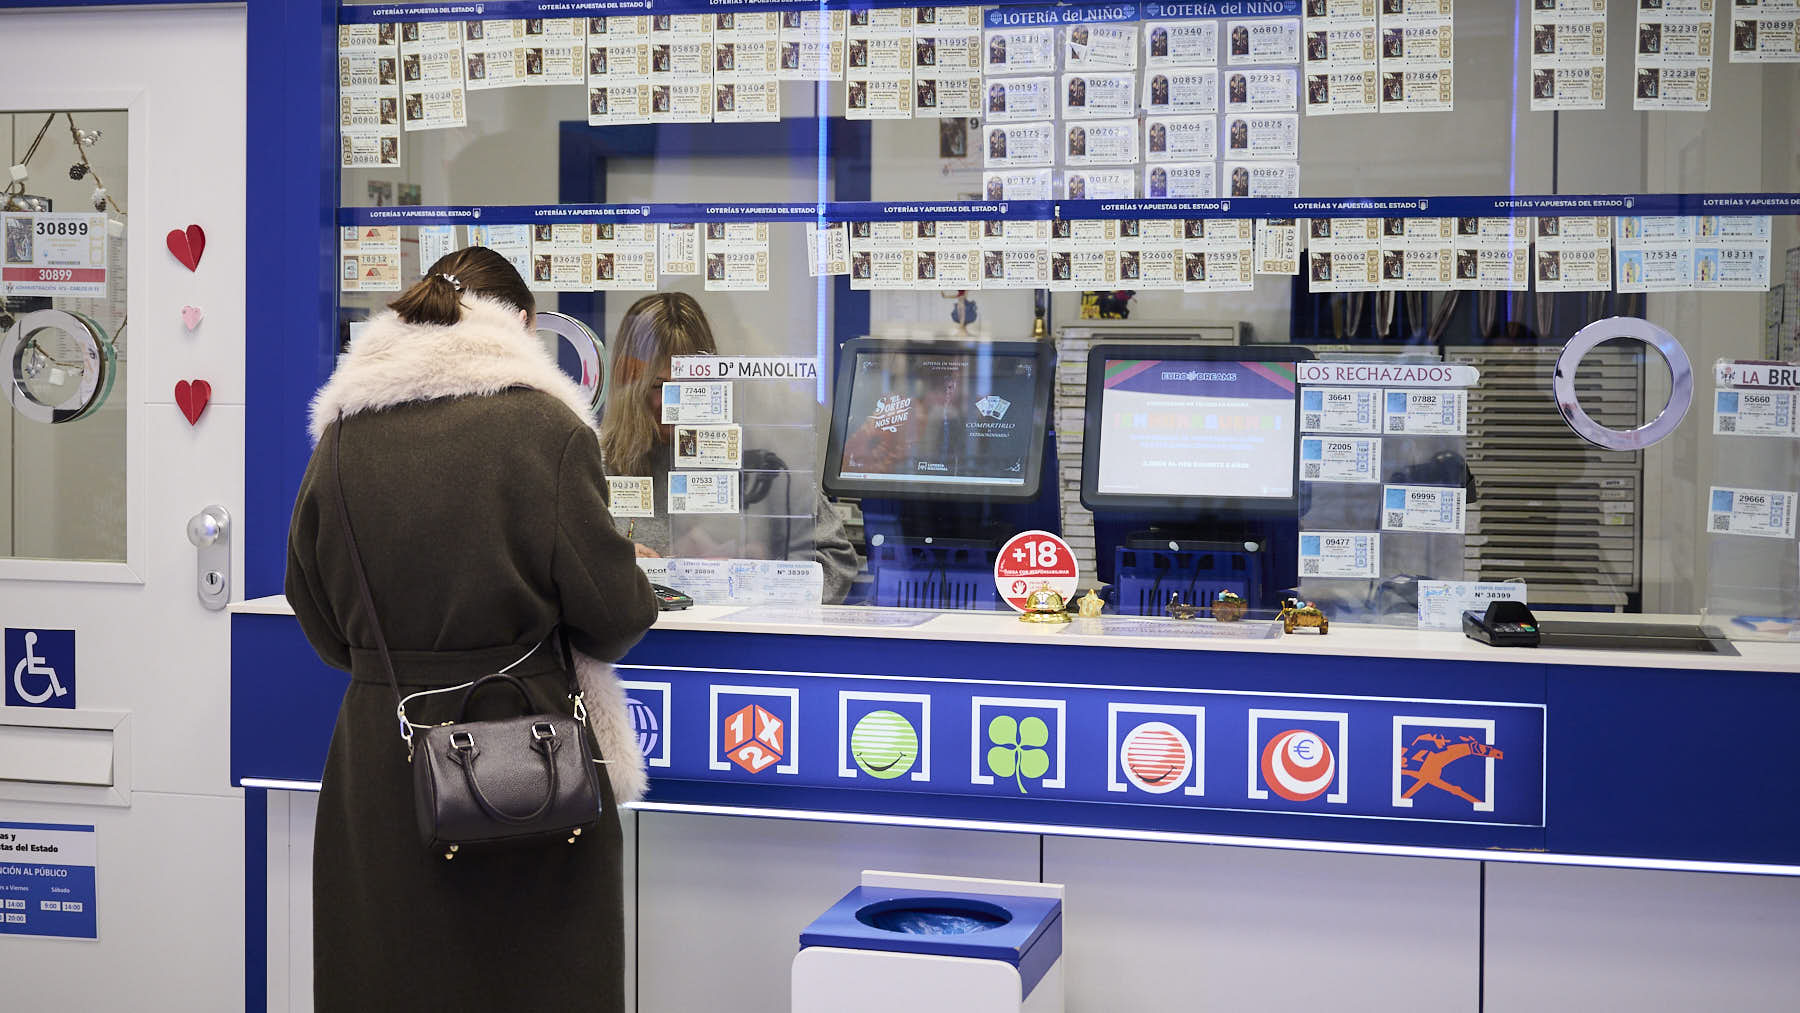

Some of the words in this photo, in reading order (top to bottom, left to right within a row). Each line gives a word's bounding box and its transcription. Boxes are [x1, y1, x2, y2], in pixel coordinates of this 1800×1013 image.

[1220, 2, 1242, 14] del
[1247, 0, 1284, 14] NIÑO
[1062, 9, 1082, 22] del
[1088, 6, 1122, 20] NIÑO
[1557, 25, 1591, 33] 21508
[1759, 21, 1794, 30] 30899
[1330, 74, 1362, 82] 41766
[1662, 70, 1696, 78] 32238
[1172, 76, 1203, 84] 00853
[609, 87, 637, 95] 40243
[1169, 123, 1200, 131] 00464
[36, 222, 88, 235] 30899
[1562, 251, 1595, 260] 00800
[1645, 251, 1677, 259] 17534
[1721, 250, 1754, 258] 18311
[39, 270, 72, 280] 30899
[690, 364, 710, 376] LOS
[719, 362, 734, 376] Dª
[739, 362, 817, 377] MANOLITA
[1300, 367, 1329, 380] LOS
[1336, 367, 1452, 382] RECHAZADOS
[1743, 371, 1759, 384] LA
[1328, 393, 1352, 402] 36641
[1412, 395, 1437, 403] 07882
[876, 397, 911, 414] SORTEO
[875, 417, 891, 428] NOS
[892, 413, 909, 424] UNE
[1327, 443, 1352, 451] 72005
[1411, 492, 1436, 501] 69995
[1739, 494, 1765, 504] 29666
[1325, 538, 1350, 546] 09477
[1012, 541, 1058, 568] +18
[31, 845, 58, 853] Estado
[35, 867, 67, 877] PÚBLICO
